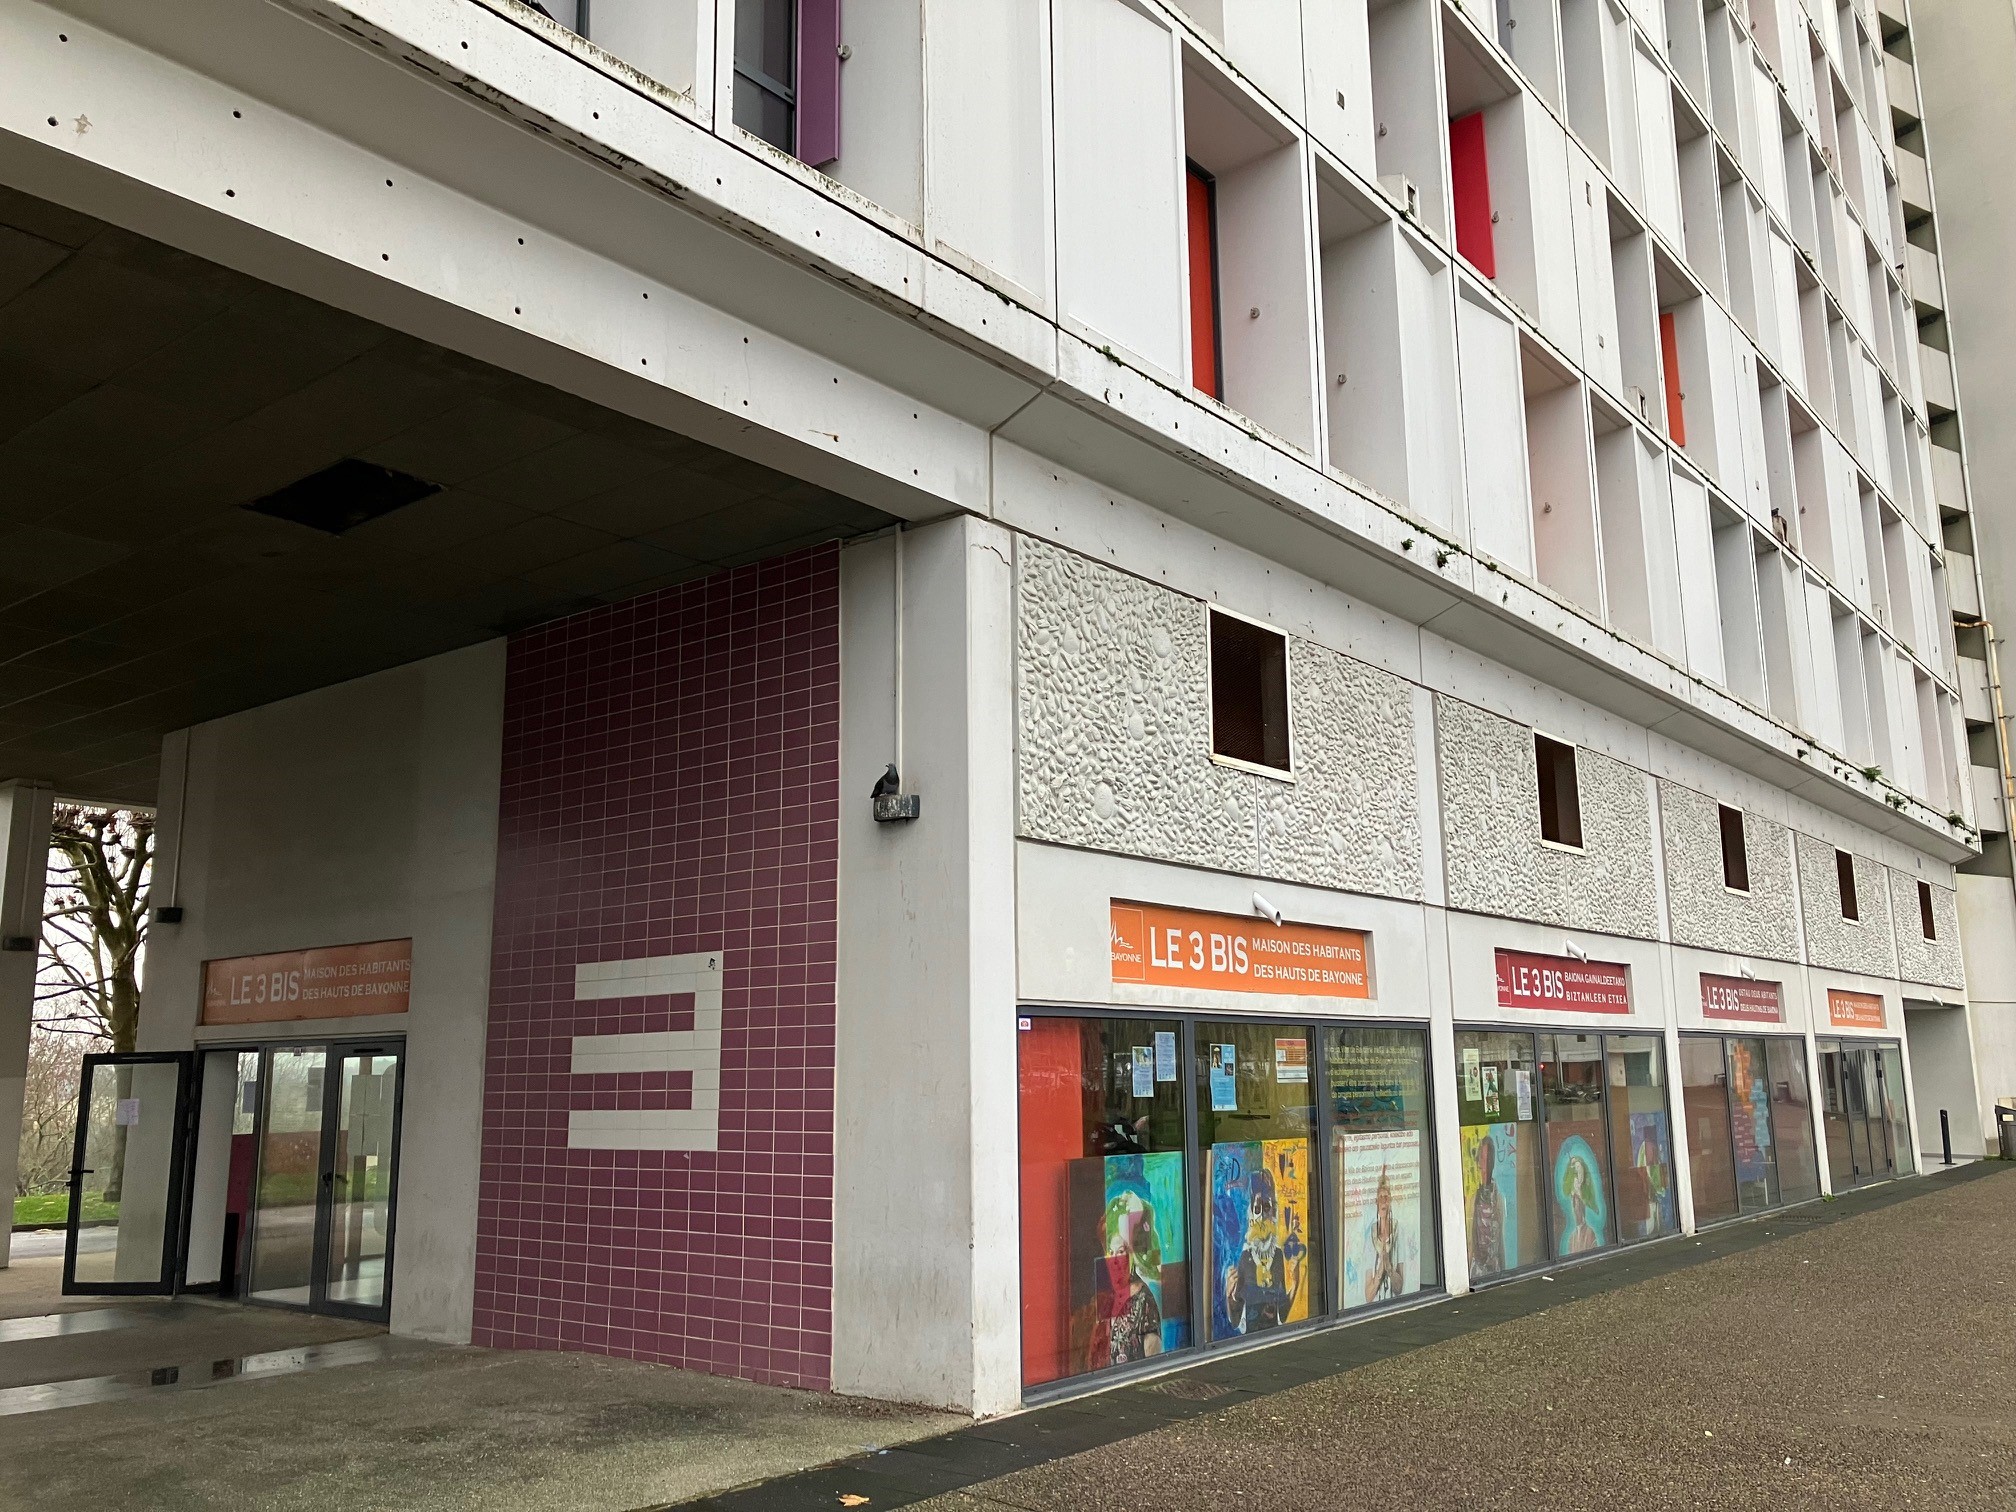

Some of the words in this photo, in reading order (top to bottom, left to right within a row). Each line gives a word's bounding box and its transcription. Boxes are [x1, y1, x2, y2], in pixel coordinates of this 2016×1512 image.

[1111, 951, 1142, 963] BAYONNE
[1149, 926, 1184, 970] LE
[1188, 930, 1205, 971] 3
[1209, 932, 1249, 975] BIS
[1252, 937, 1291, 955] MAISON
[1292, 942, 1311, 957] DES
[1312, 944, 1362, 962] HABITANTS
[303, 966, 337, 980] MAISON
[339, 964, 358, 976] DES
[359, 958, 411, 976] HABITANTS
[1253, 963, 1274, 979] DES
[1275, 965, 1307, 982] HAUTS
[1308, 968, 1321, 982] DE
[1322, 969, 1364, 986] BAYONNE
[1564, 971, 1584, 983] BAIONA
[230, 974, 253, 1005] LE
[255, 973, 267, 1004] 3
[270, 970, 300, 1002] BIS
[302, 988, 319, 1001] DES
[320, 985, 350, 999] HAUTS
[351, 984, 363, 996] DE
[364, 980, 410, 996] BAYONNE
[1511, 966, 1531, 997] LE
[1531, 968, 1542, 998] 3
[1542, 969, 1564, 999] BIS
[1566, 990, 1607, 1004] BIZTANLEEN
[1608, 994, 1628, 1005] ETXEA
[1706, 986, 1720, 1010] LE
[1719, 987, 1726, 1011] 3
[1725, 988, 1740, 1012] BIS
[567, 950, 724, 1151] 3
